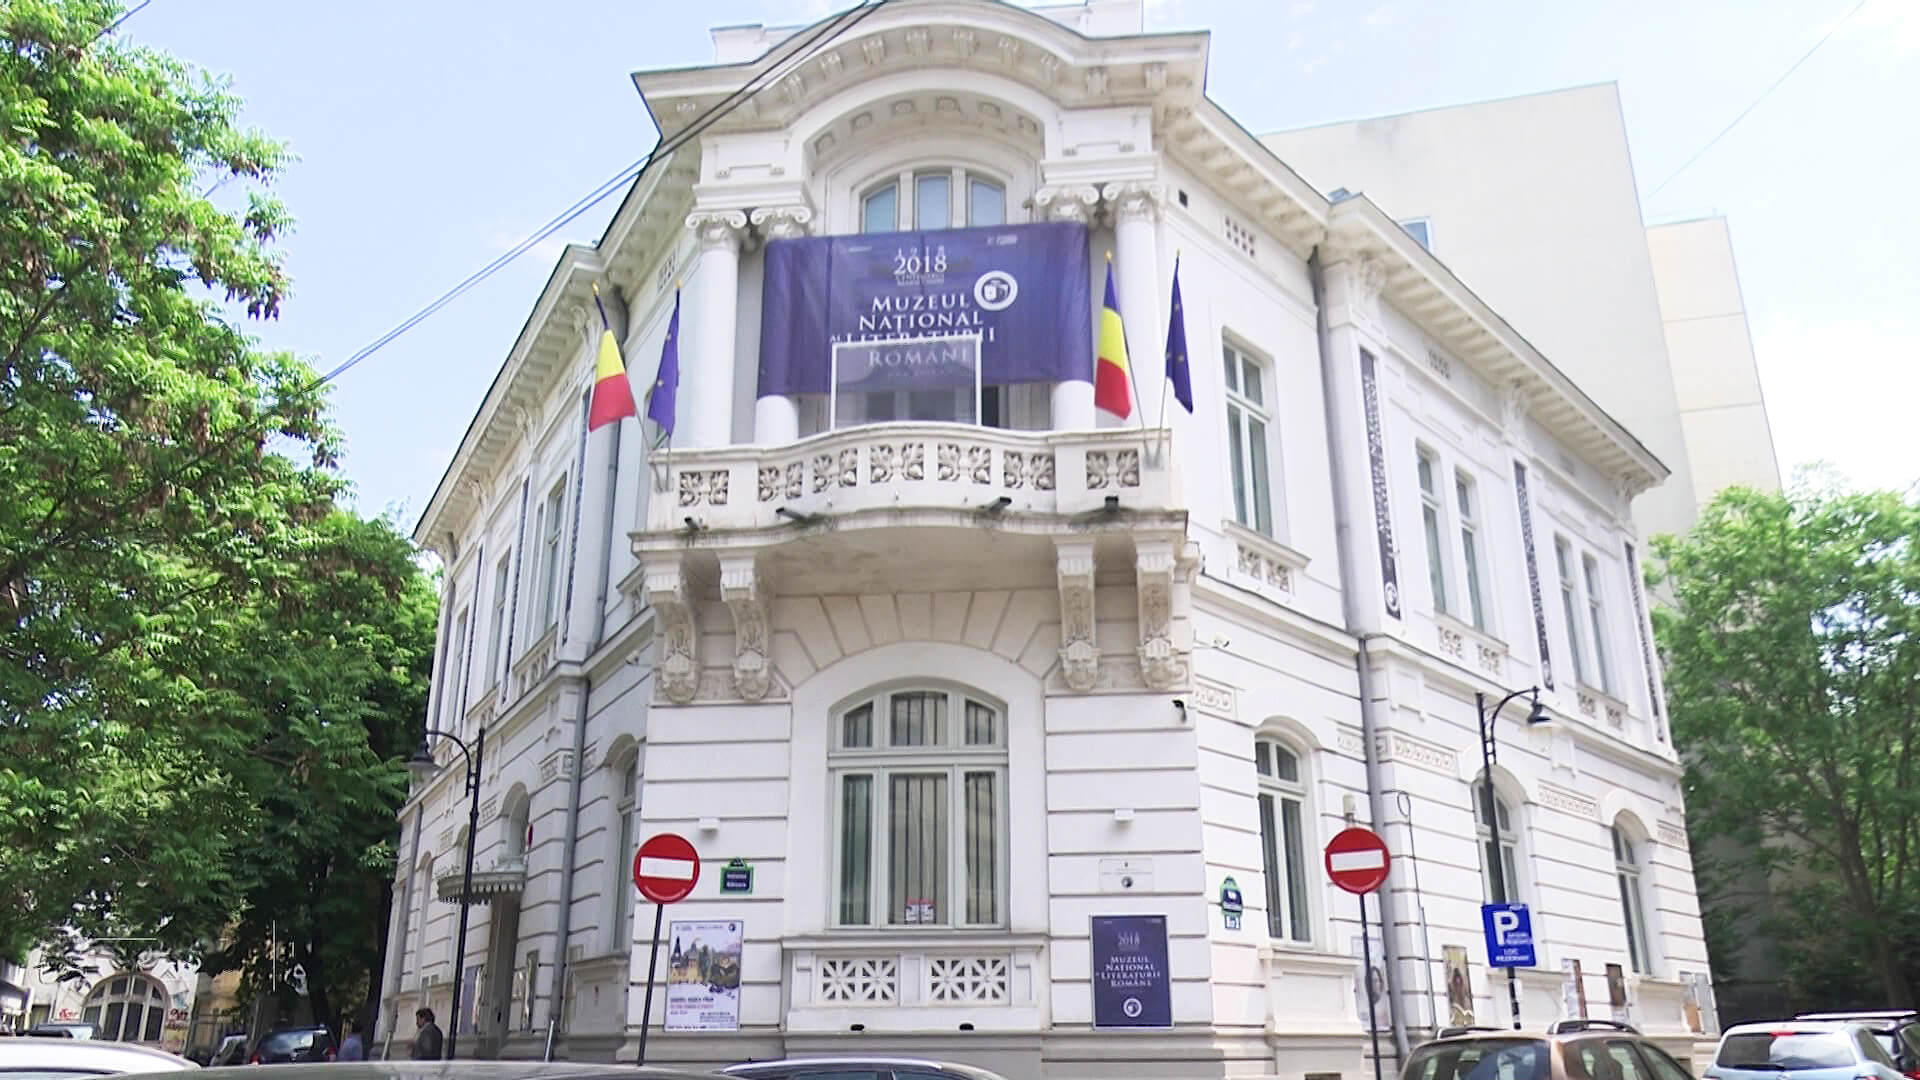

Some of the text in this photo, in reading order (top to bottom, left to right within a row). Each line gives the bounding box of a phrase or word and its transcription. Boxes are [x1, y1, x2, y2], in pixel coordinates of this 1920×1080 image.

[894, 256, 947, 275] 2018
[871, 294, 970, 313] MUZEUL
[1493, 911, 1519, 945] P
[1110, 956, 1150, 964] MUZEUL
